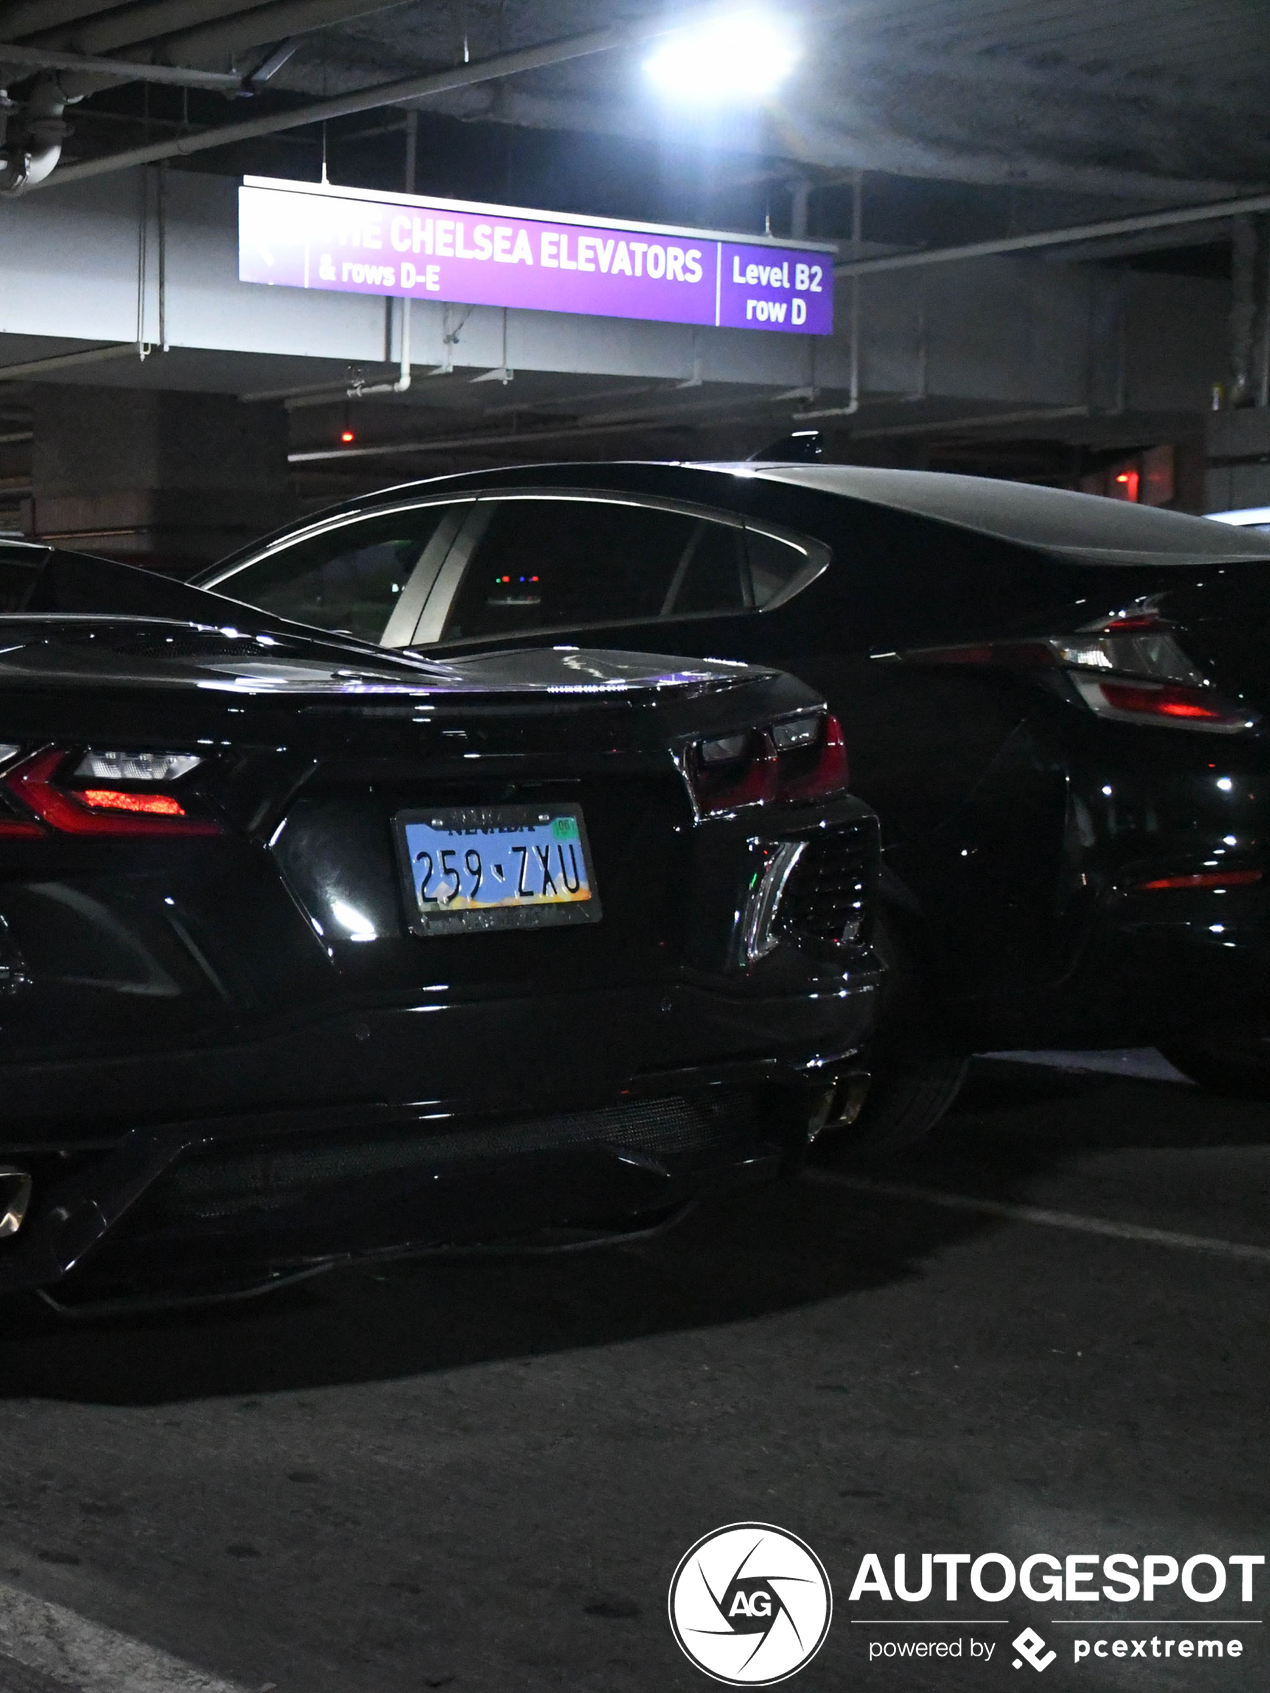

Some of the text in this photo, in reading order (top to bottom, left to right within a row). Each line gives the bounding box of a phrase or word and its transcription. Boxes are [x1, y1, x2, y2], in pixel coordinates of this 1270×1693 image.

[320, 207, 703, 284] HE CHELSEA ELEVATORS
[319, 254, 440, 292] & rows D-E
[733, 256, 823, 293] Level B2
[746, 297, 807, 326] row D
[415, 844, 580, 904] 259 ZXU
